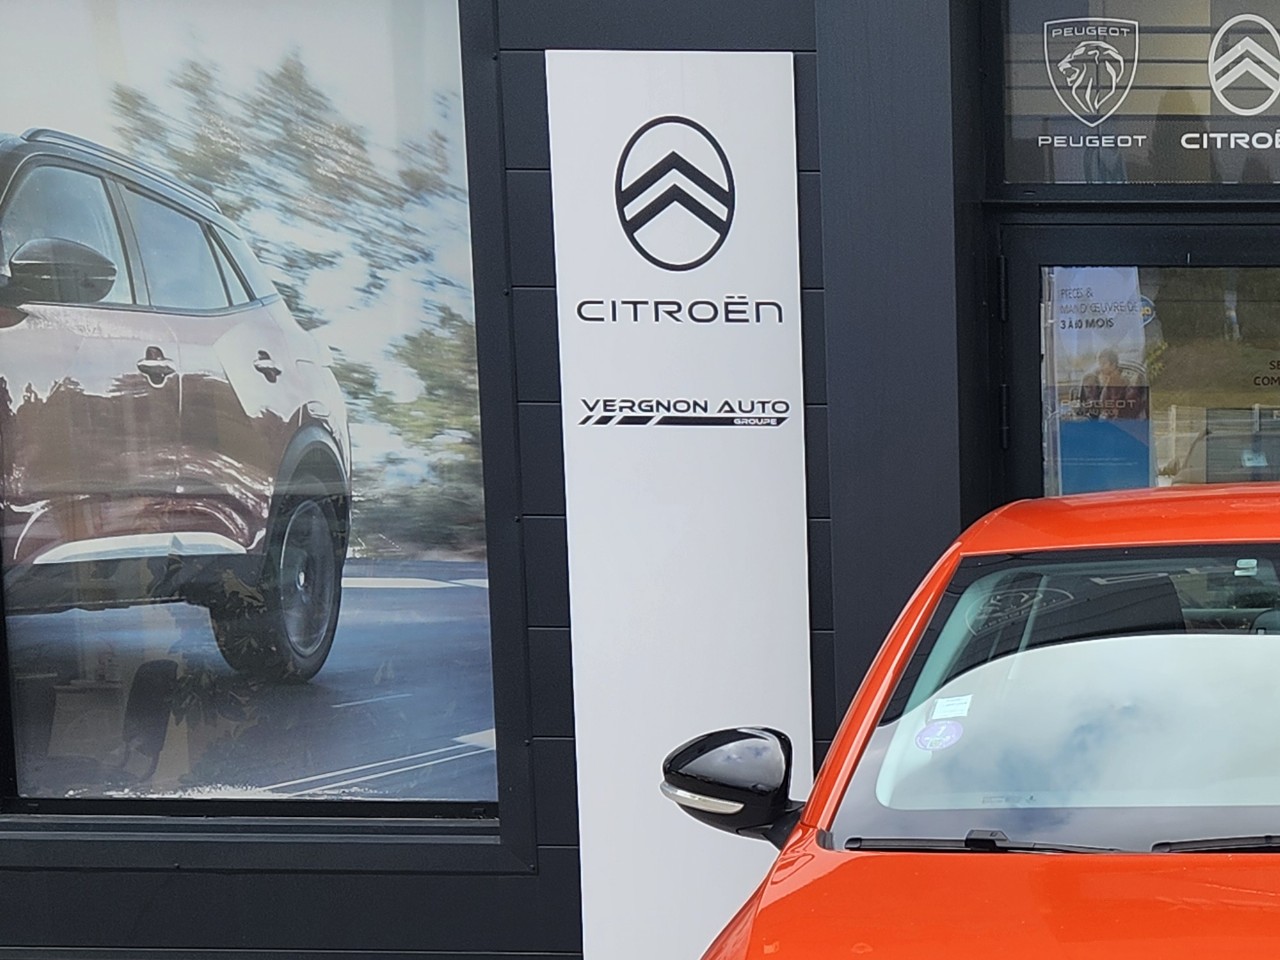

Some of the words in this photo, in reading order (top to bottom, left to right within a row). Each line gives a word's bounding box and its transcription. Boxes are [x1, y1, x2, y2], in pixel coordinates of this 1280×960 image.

[1051, 26, 1131, 38] PEUGEOT
[1038, 135, 1147, 147] PEUGEOT
[581, 399, 708, 414] VERGNON
[717, 400, 790, 414] AUTO
[733, 417, 778, 426] GROUPE
